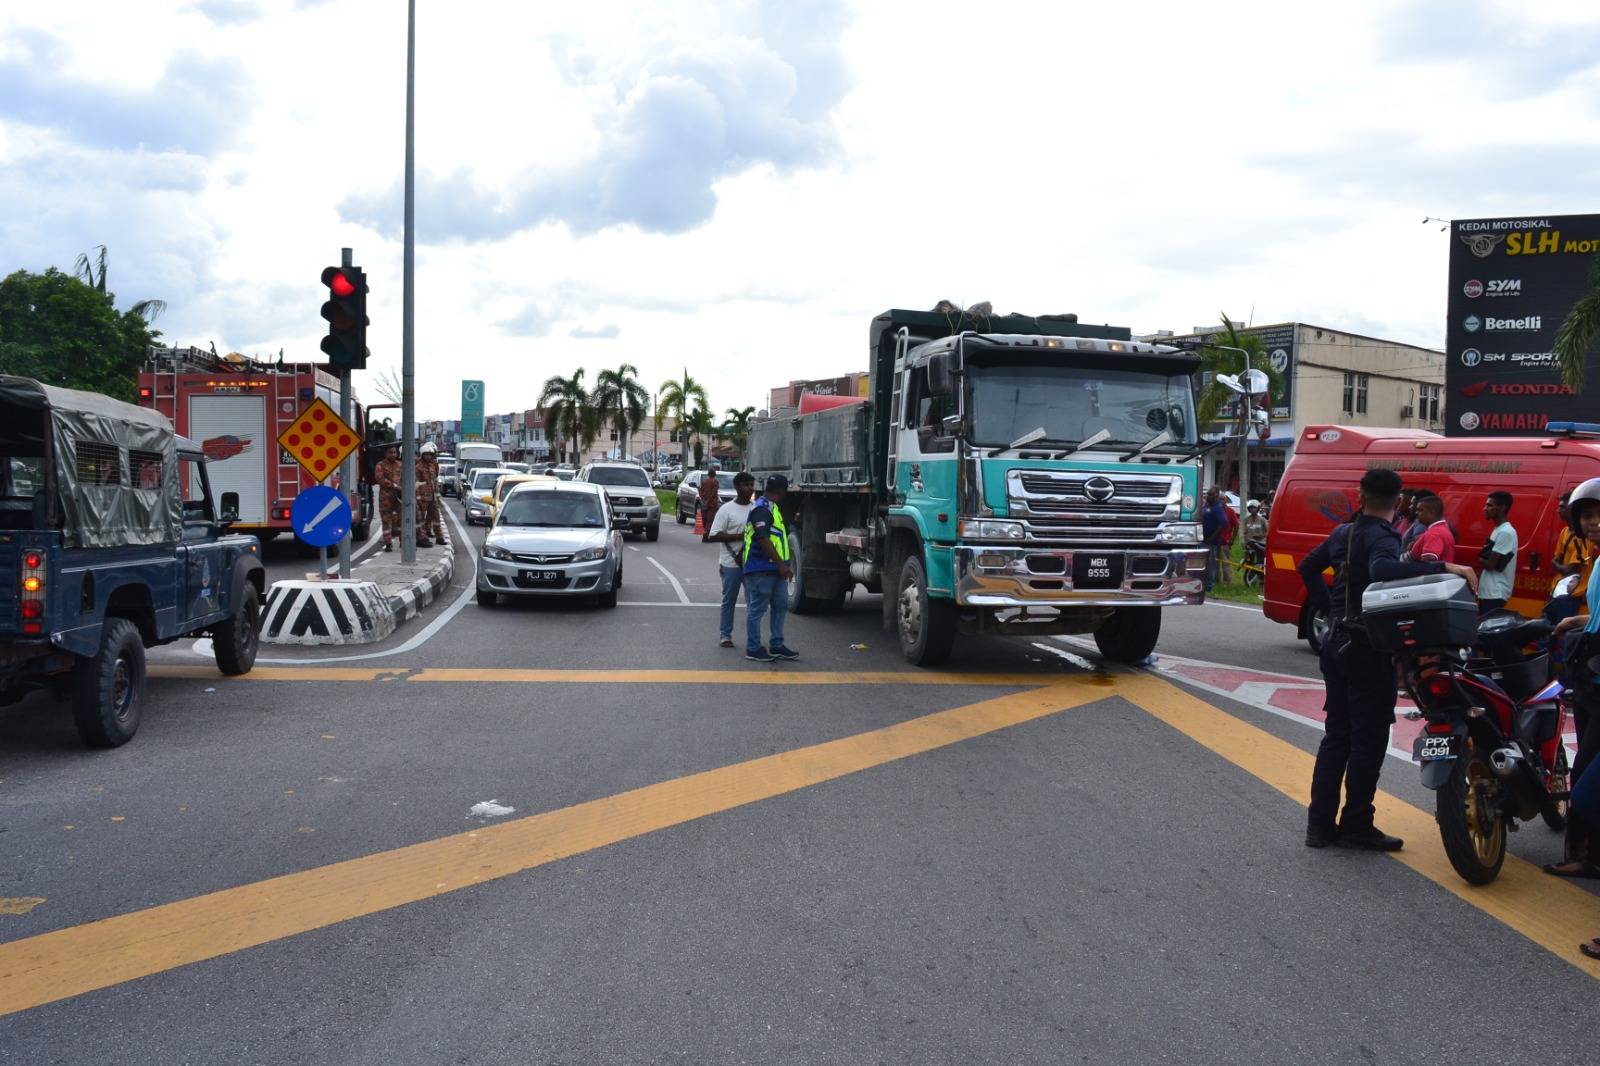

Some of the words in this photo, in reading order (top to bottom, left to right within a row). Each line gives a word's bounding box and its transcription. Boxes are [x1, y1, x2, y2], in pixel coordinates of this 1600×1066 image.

[1459, 223, 1490, 231] KEDAI
[1493, 220, 1552, 230] MOTOSIKAL
[1506, 231, 1560, 255] SLH
[1487, 280, 1521, 291] SYM
[1485, 316, 1541, 330] Benelli
[1483, 353, 1506, 361] SM
[1490, 384, 1575, 394] HONDA
[1481, 413, 1549, 429] YAMAHA
[1091, 558, 1107, 567] MBX
[527, 571, 539, 579] PLJ
[543, 571, 557, 579] 1271
[1088, 568, 1110, 577] 9555
[1425, 736, 1449, 747] PPX
[1421, 746, 1450, 757] 6091
